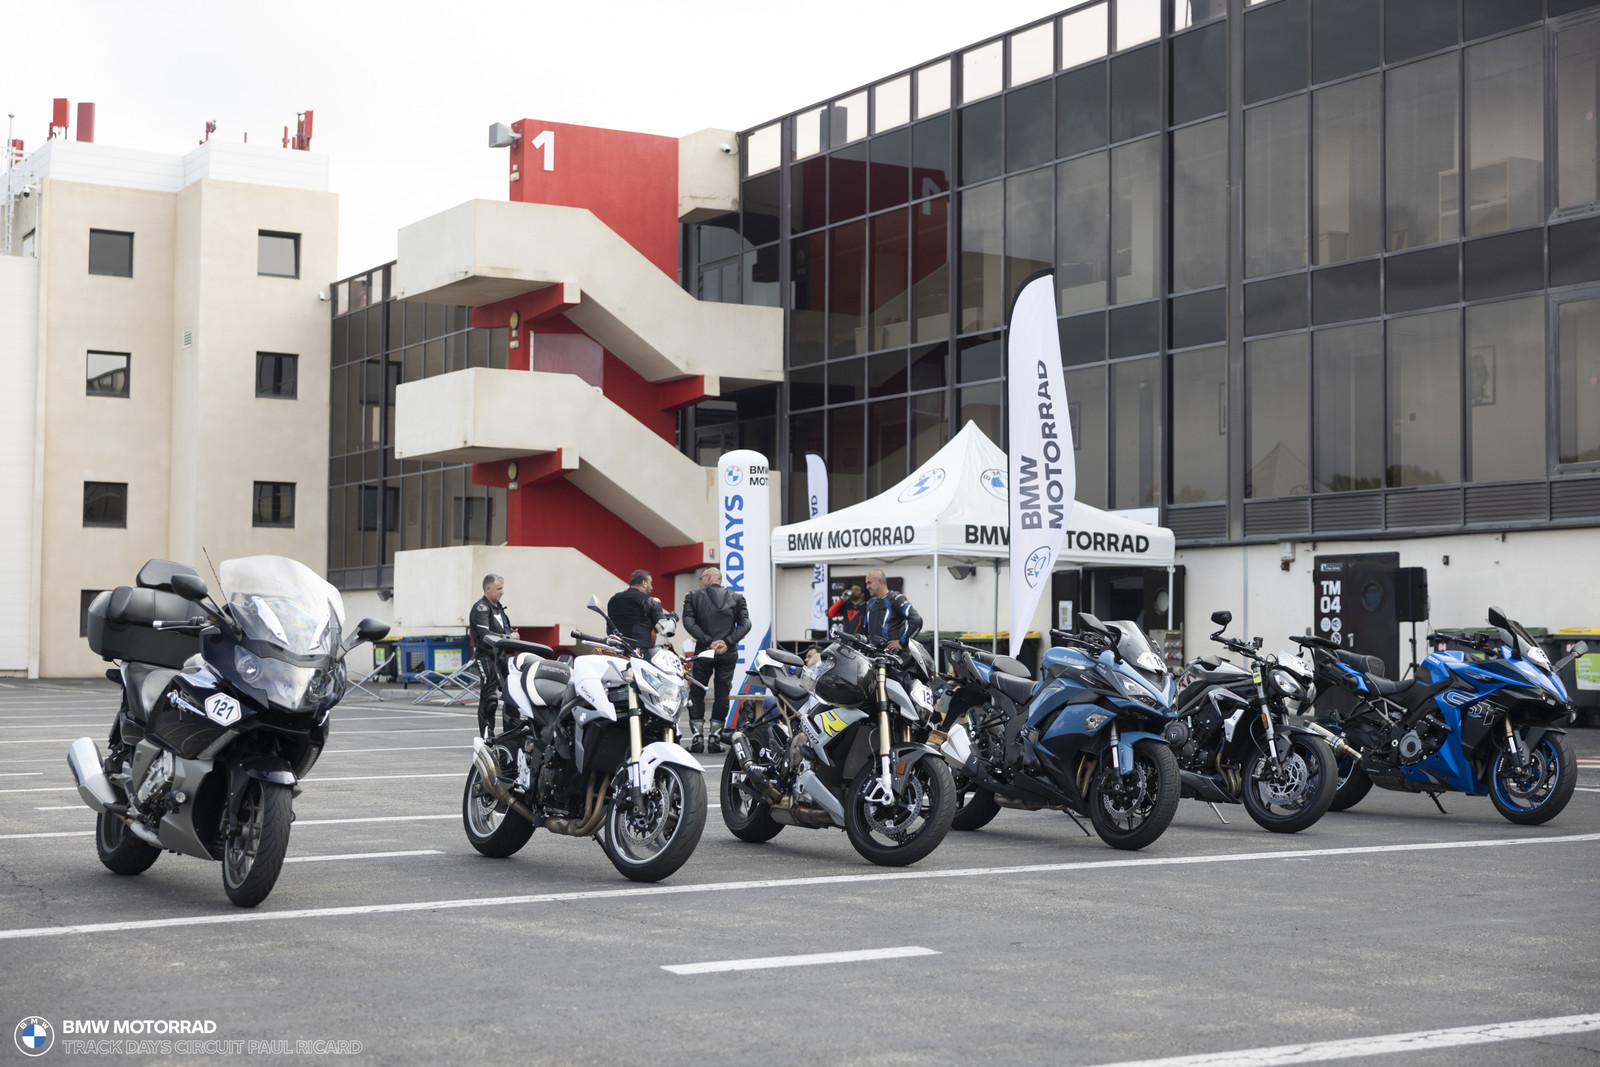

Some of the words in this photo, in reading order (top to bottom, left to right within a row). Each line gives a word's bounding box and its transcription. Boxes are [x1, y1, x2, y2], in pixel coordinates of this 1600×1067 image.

[531, 130, 555, 172] 1
[1037, 359, 1064, 530] MOTORRAD
[1019, 454, 1043, 530] BMW
[788, 531, 824, 551] BMW
[828, 525, 915, 549] MOTORRAD
[1066, 530, 1150, 553] TORRAD
[1320, 580, 1341, 595] TM
[1320, 596, 1341, 613] 04
[213, 699, 234, 720] 121
